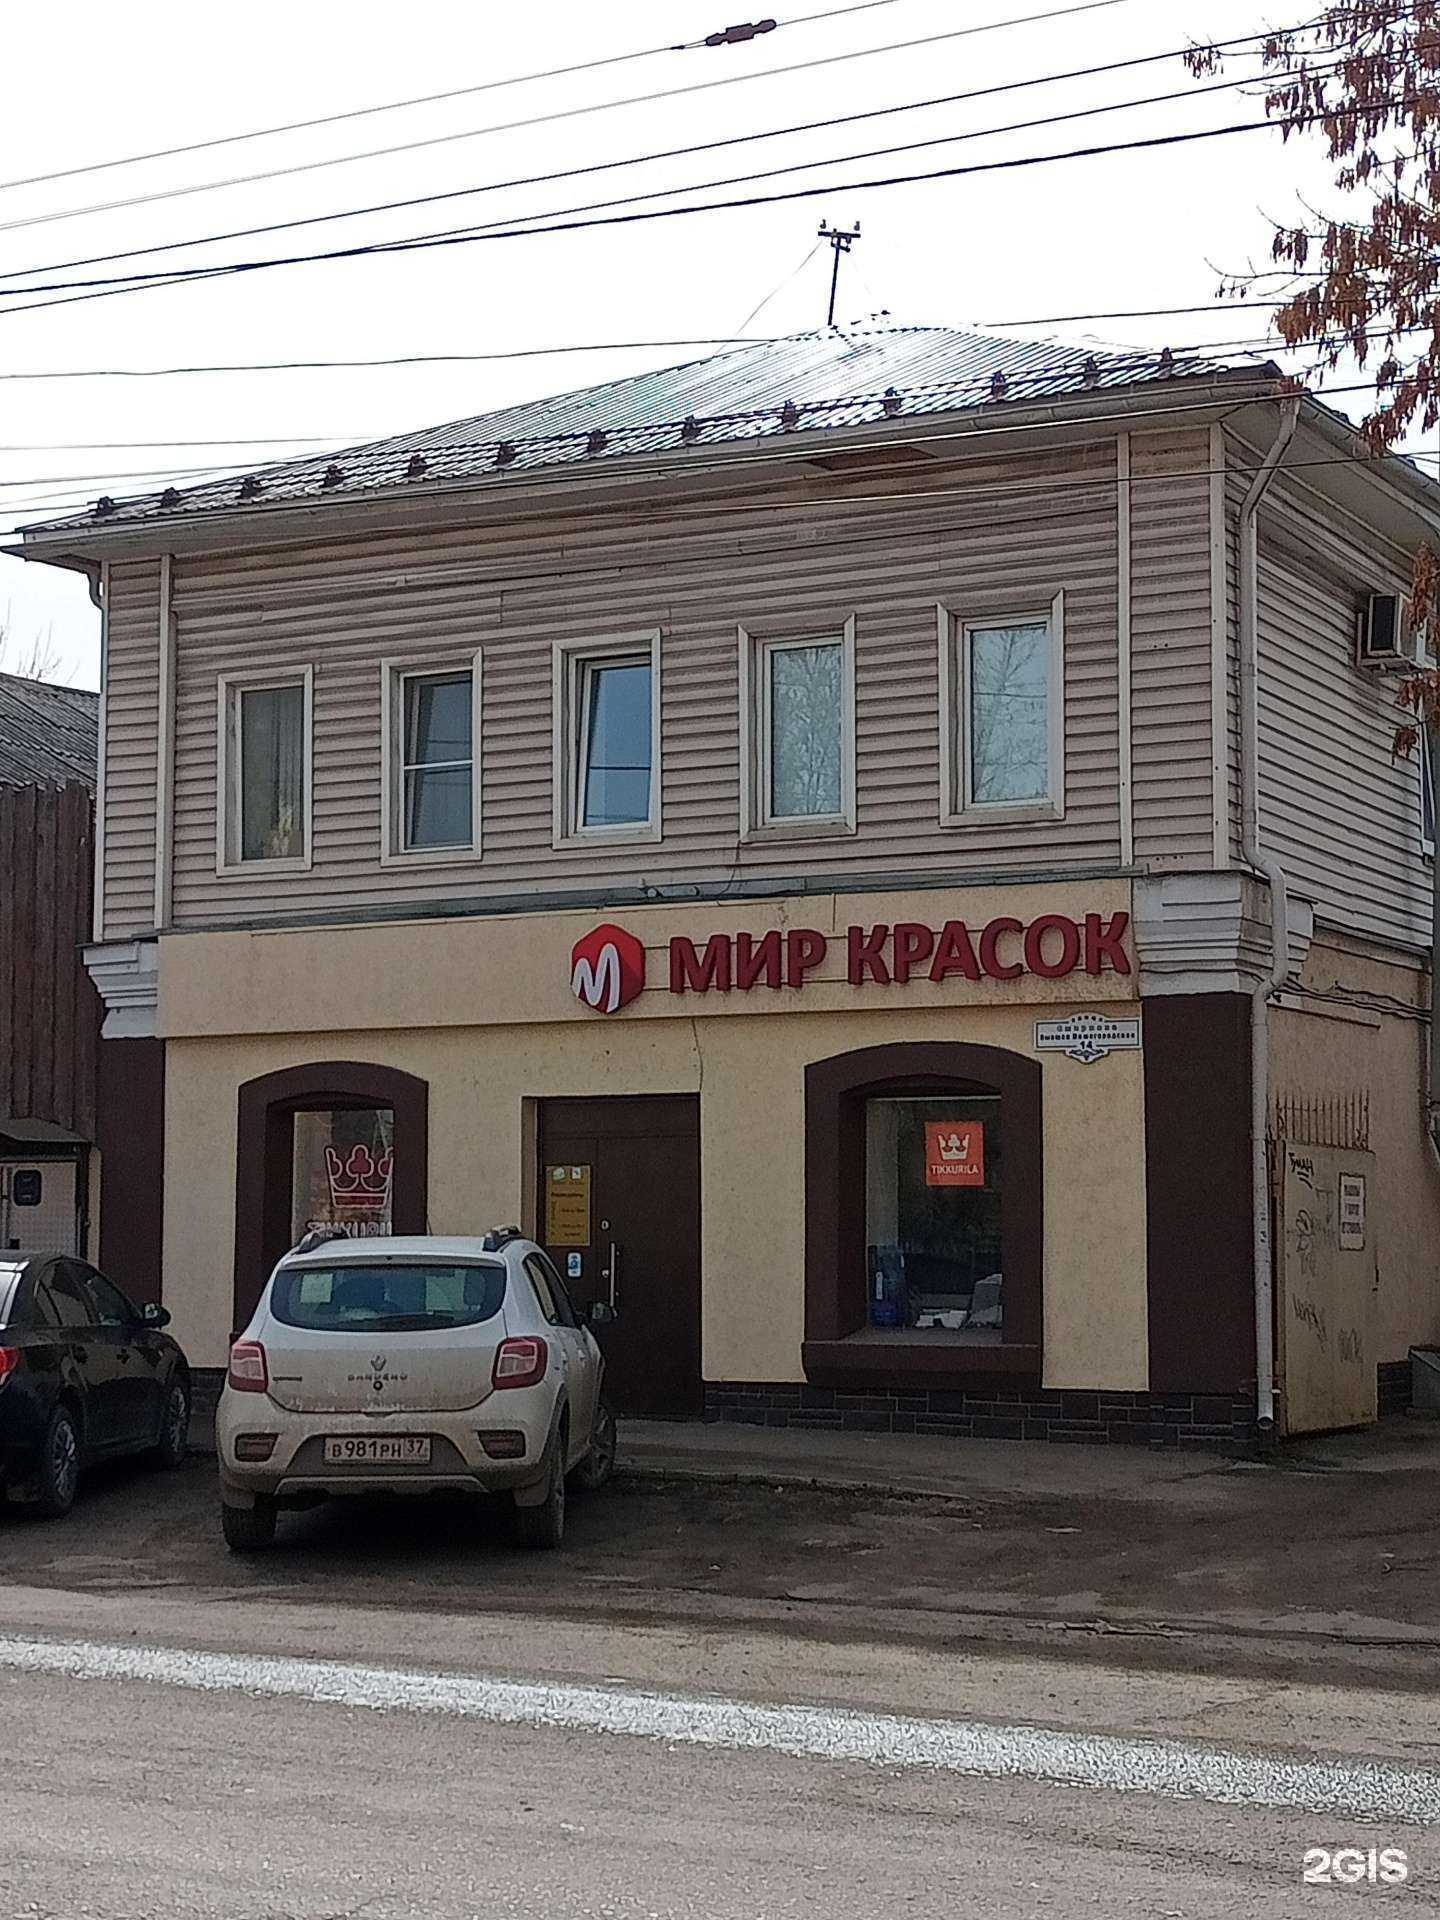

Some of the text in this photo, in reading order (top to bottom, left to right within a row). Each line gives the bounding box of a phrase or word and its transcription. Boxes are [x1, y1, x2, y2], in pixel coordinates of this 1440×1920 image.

[669, 911, 1131, 993] МИР КРАСОК
[1080, 1041, 1093, 1049] 14
[931, 1164, 979, 1175] TIKKURILA
